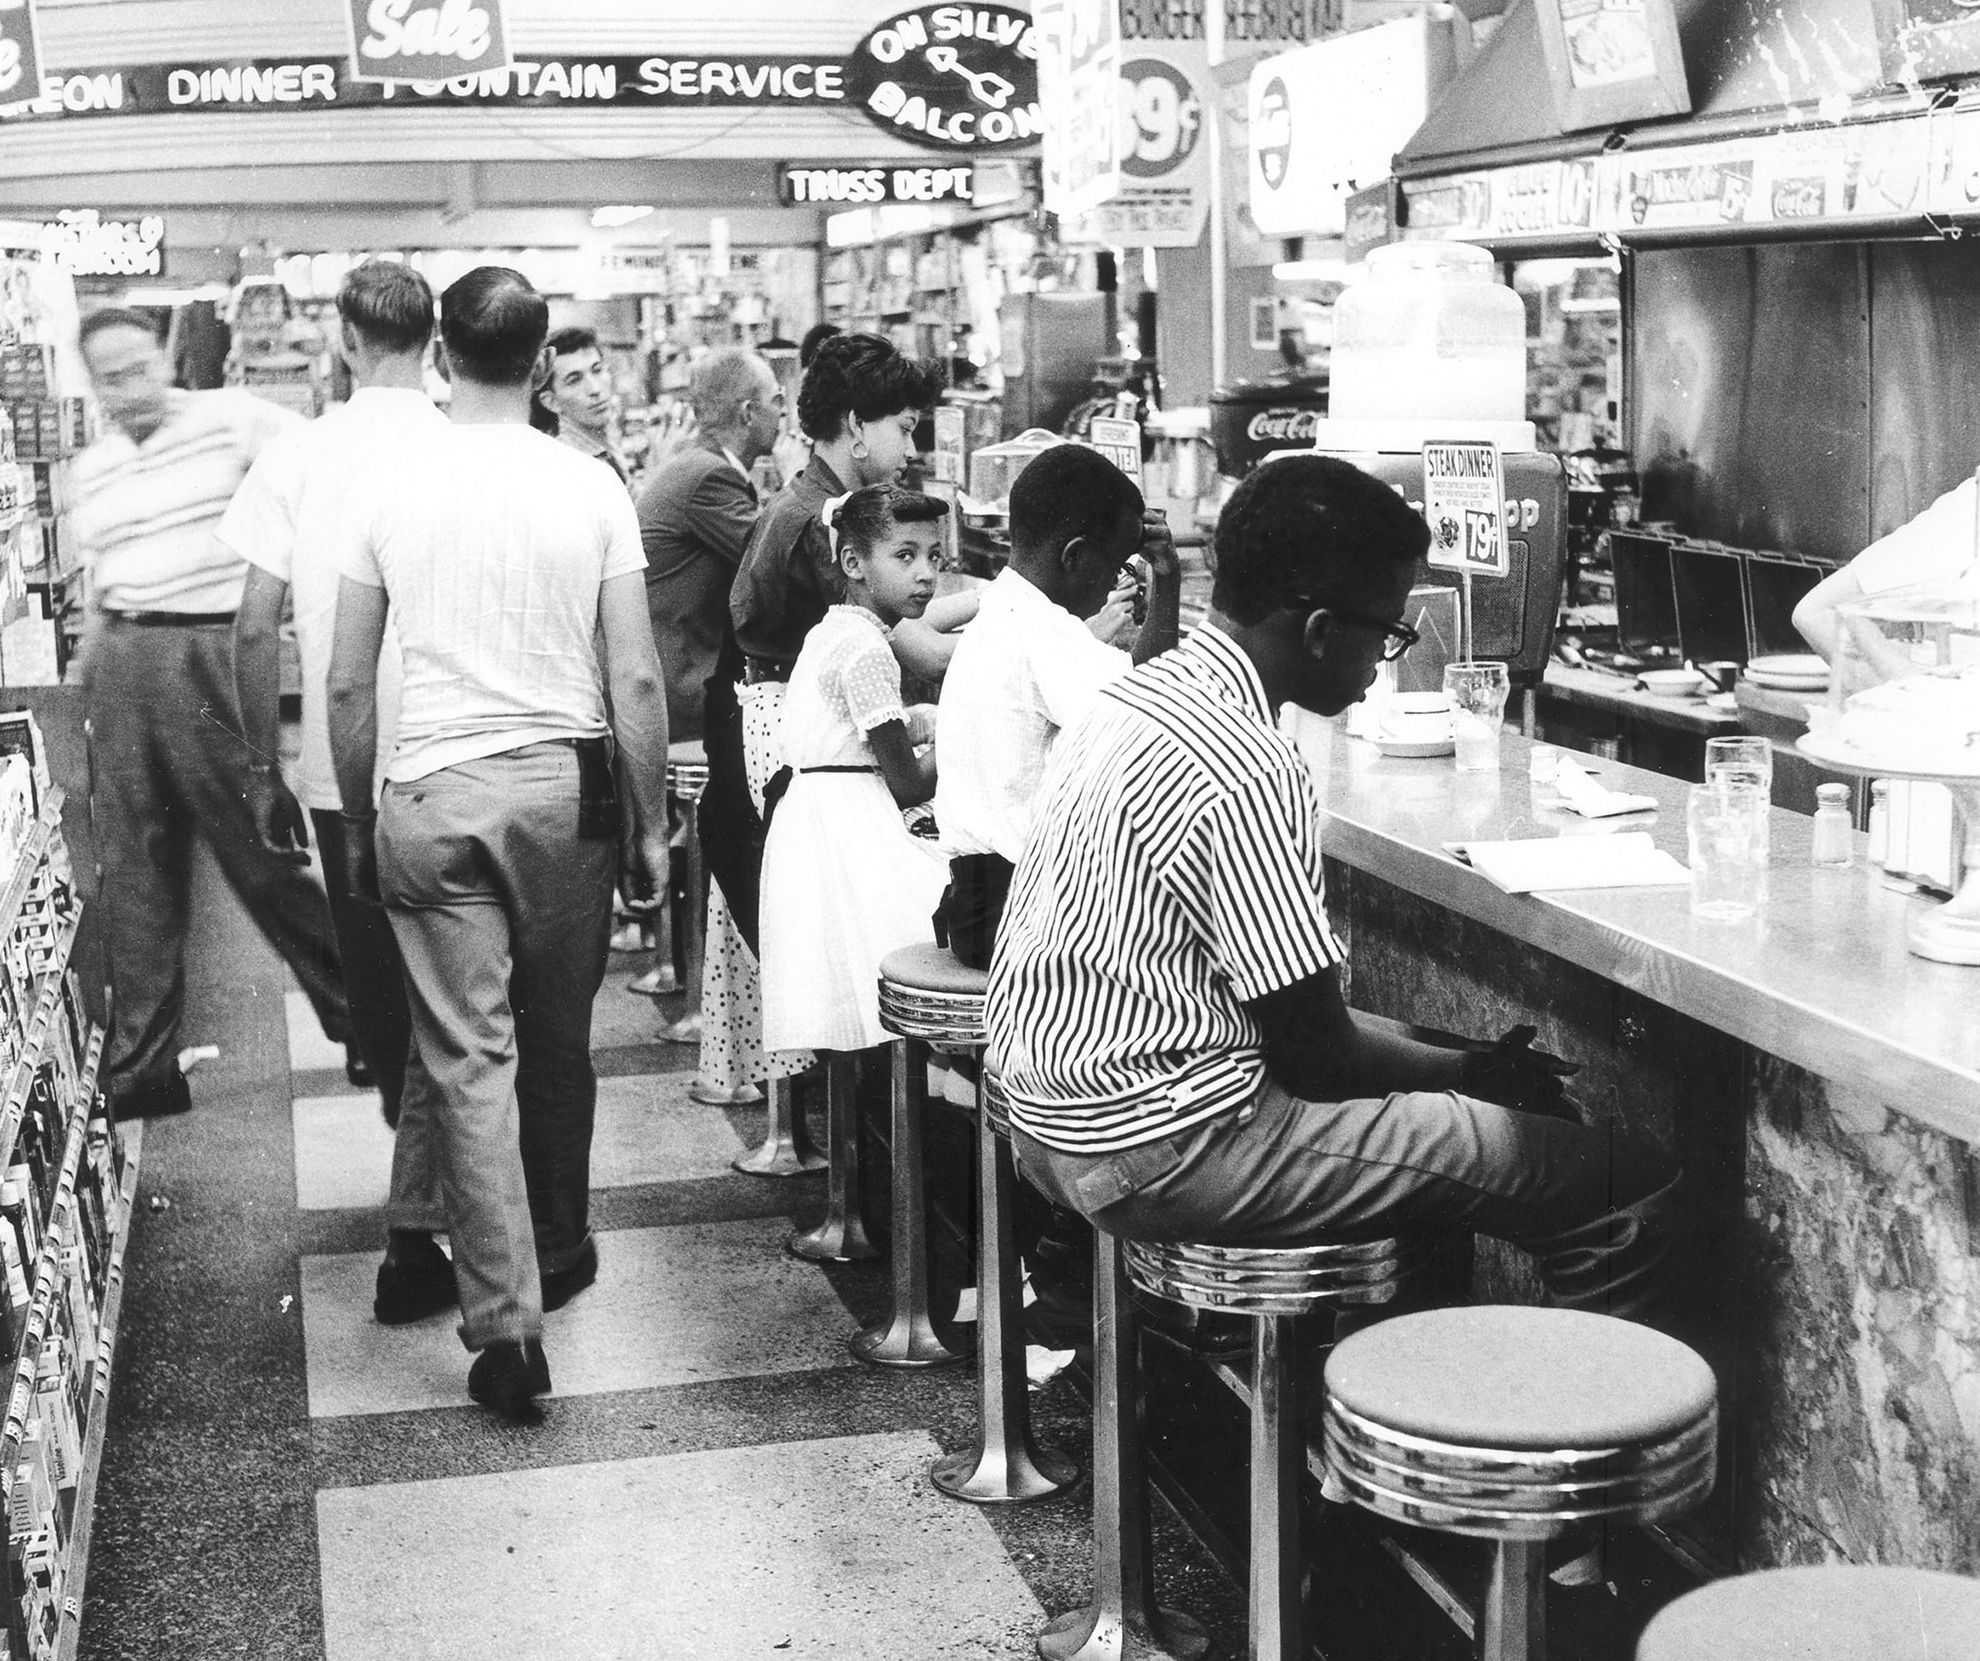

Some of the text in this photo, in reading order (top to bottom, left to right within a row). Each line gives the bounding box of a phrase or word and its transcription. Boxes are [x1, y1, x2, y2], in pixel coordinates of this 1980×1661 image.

[361, 0, 491, 60] Sale
[870, 7, 1039, 63] ON SILVE
[168, 65, 336, 104] DINNER
[638, 57, 845, 99] SERVICE
[867, 81, 1045, 142] BALCON
[787, 169, 886, 202] TRUSS
[1427, 449, 1494, 479] STEAK DINNER
